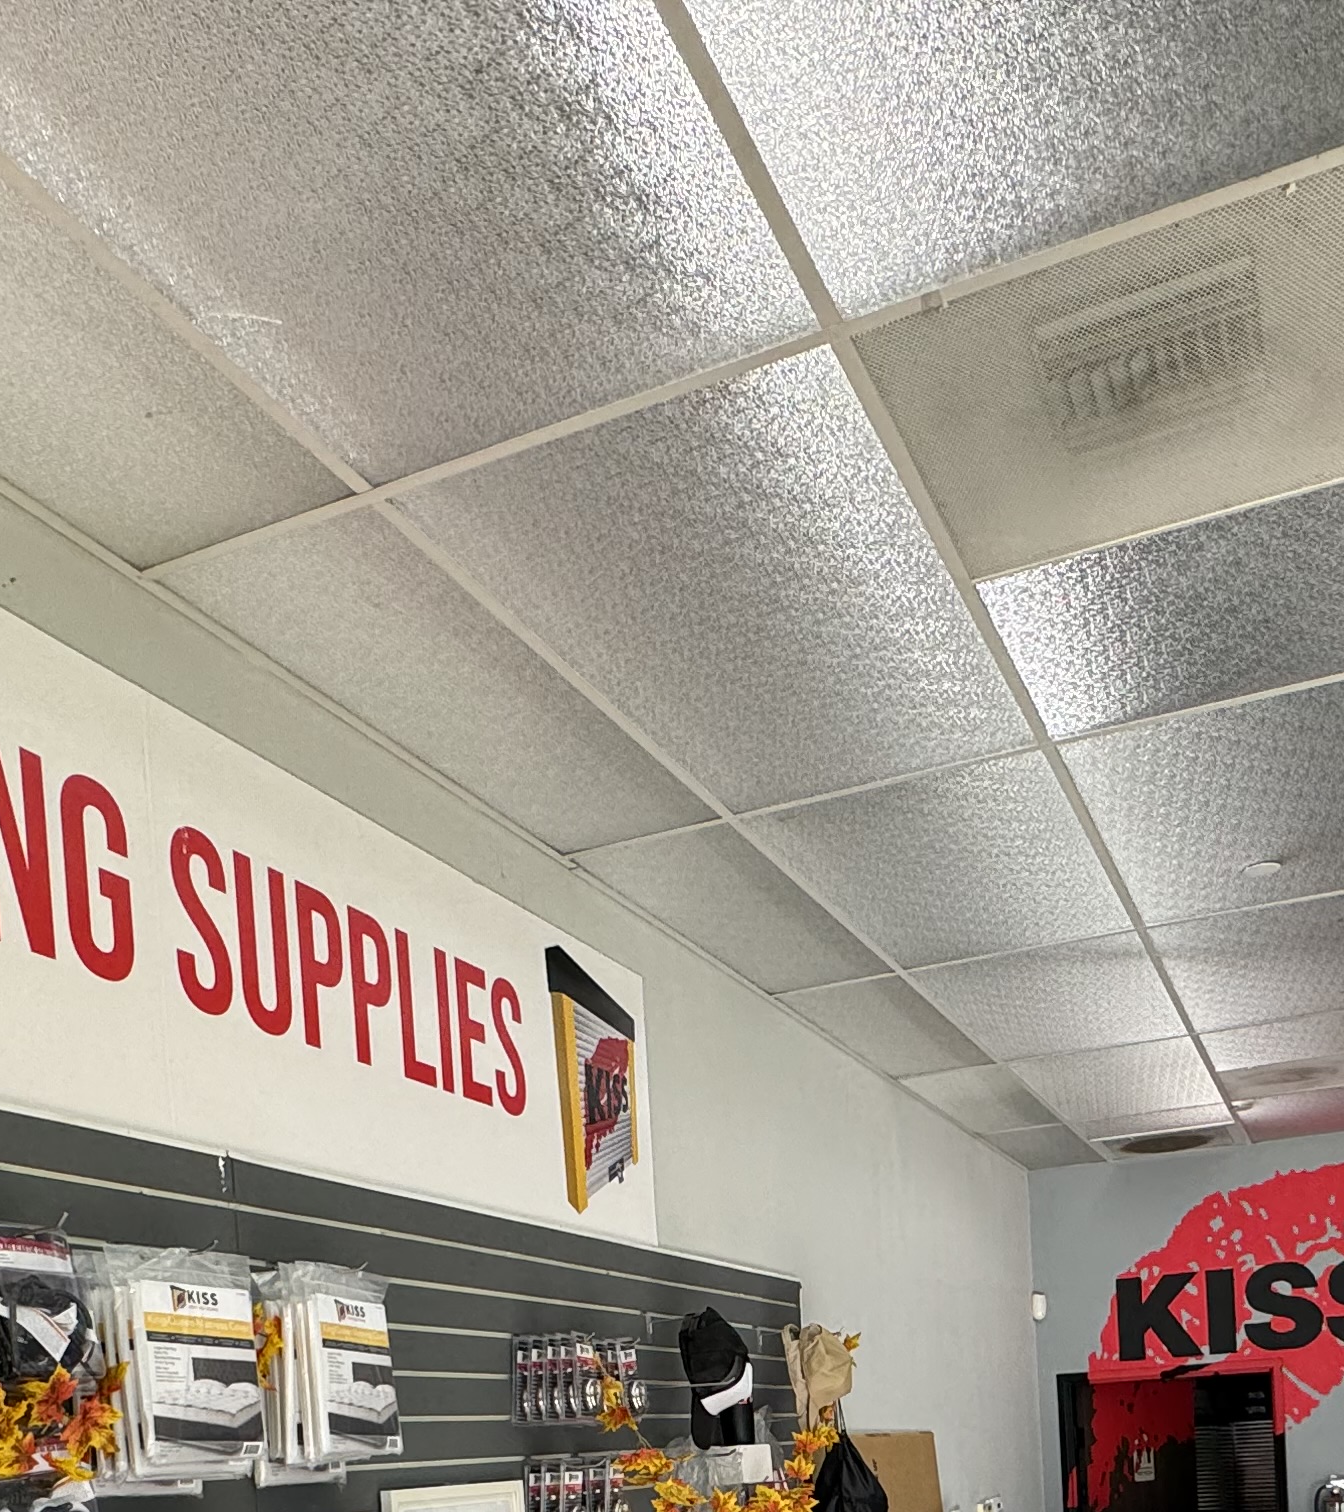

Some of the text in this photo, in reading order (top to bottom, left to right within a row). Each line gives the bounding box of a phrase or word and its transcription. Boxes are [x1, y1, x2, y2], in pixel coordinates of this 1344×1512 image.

[169, 826, 526, 1117] SUPPLIES
[584, 1063, 629, 1124] KISS
[187, 1289, 218, 1306] KISS
